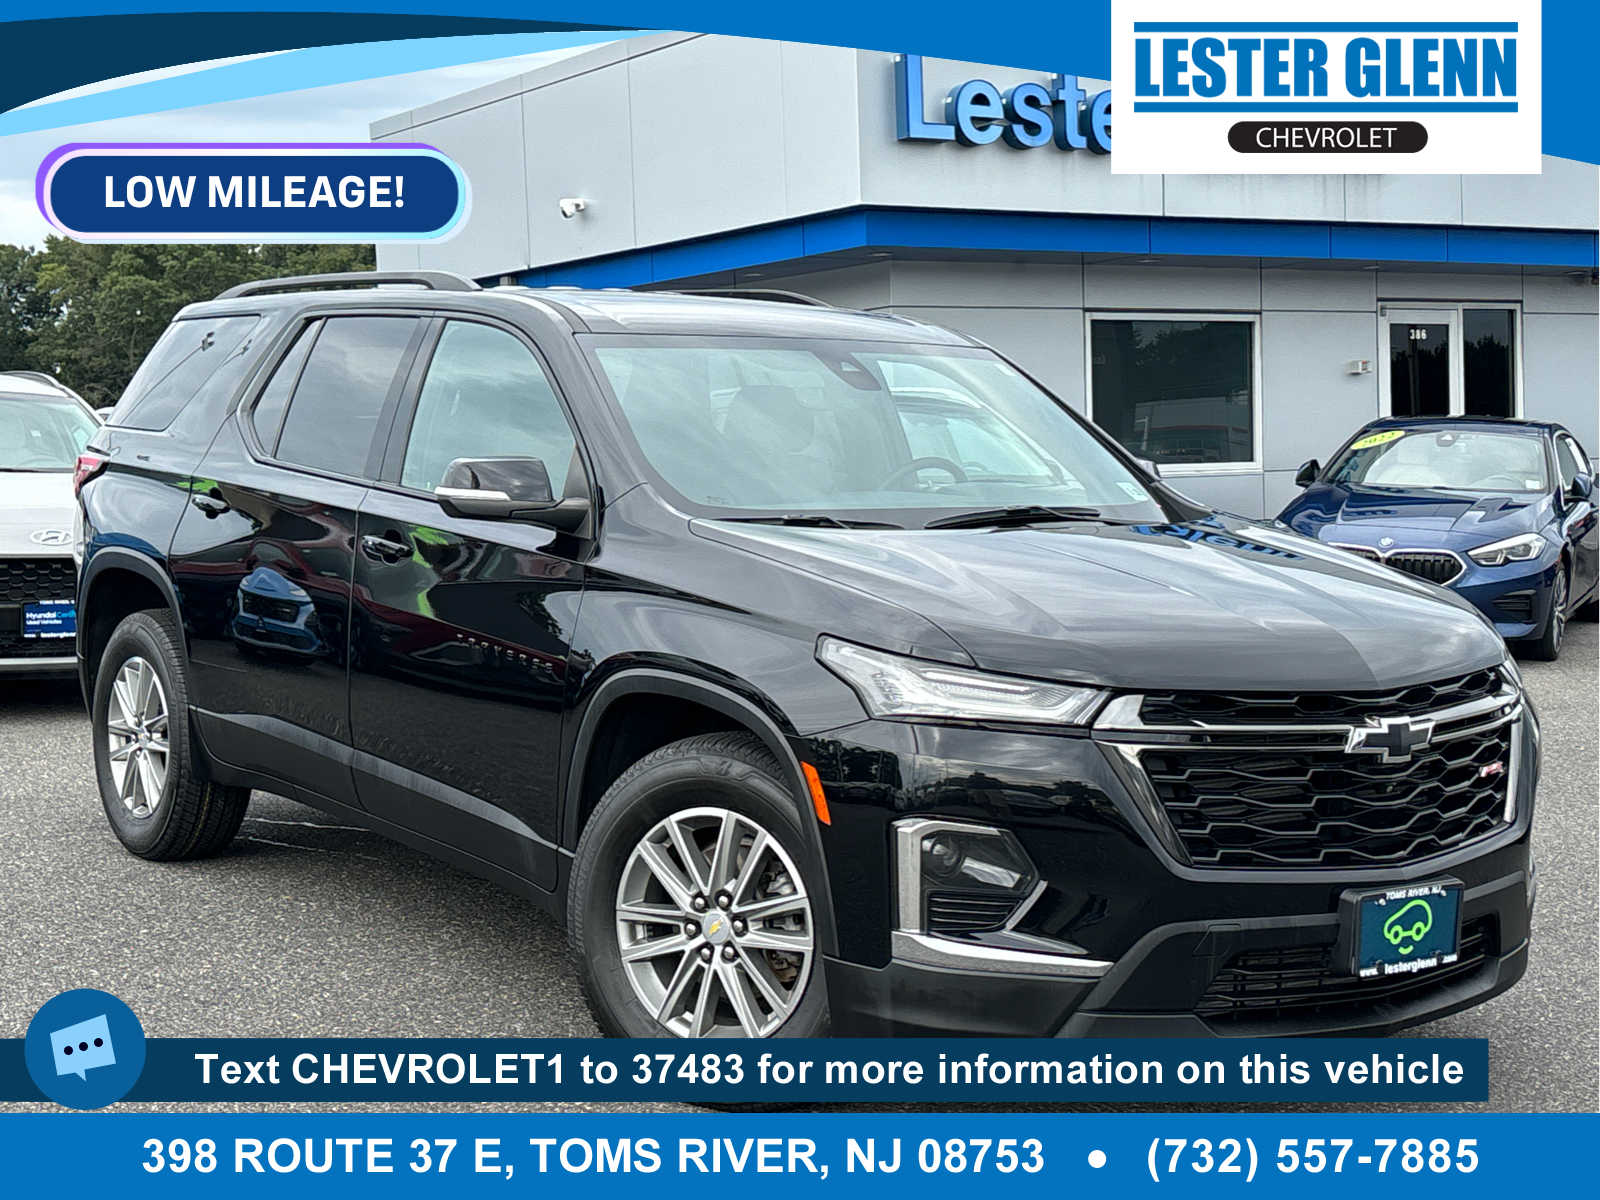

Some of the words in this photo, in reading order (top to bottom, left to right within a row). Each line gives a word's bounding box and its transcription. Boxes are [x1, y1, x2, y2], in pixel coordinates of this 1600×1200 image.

[1409, 329, 1428, 340] 386
[1386, 889, 1407, 900] TOMS
[1384, 957, 1438, 975] lesterglenn
